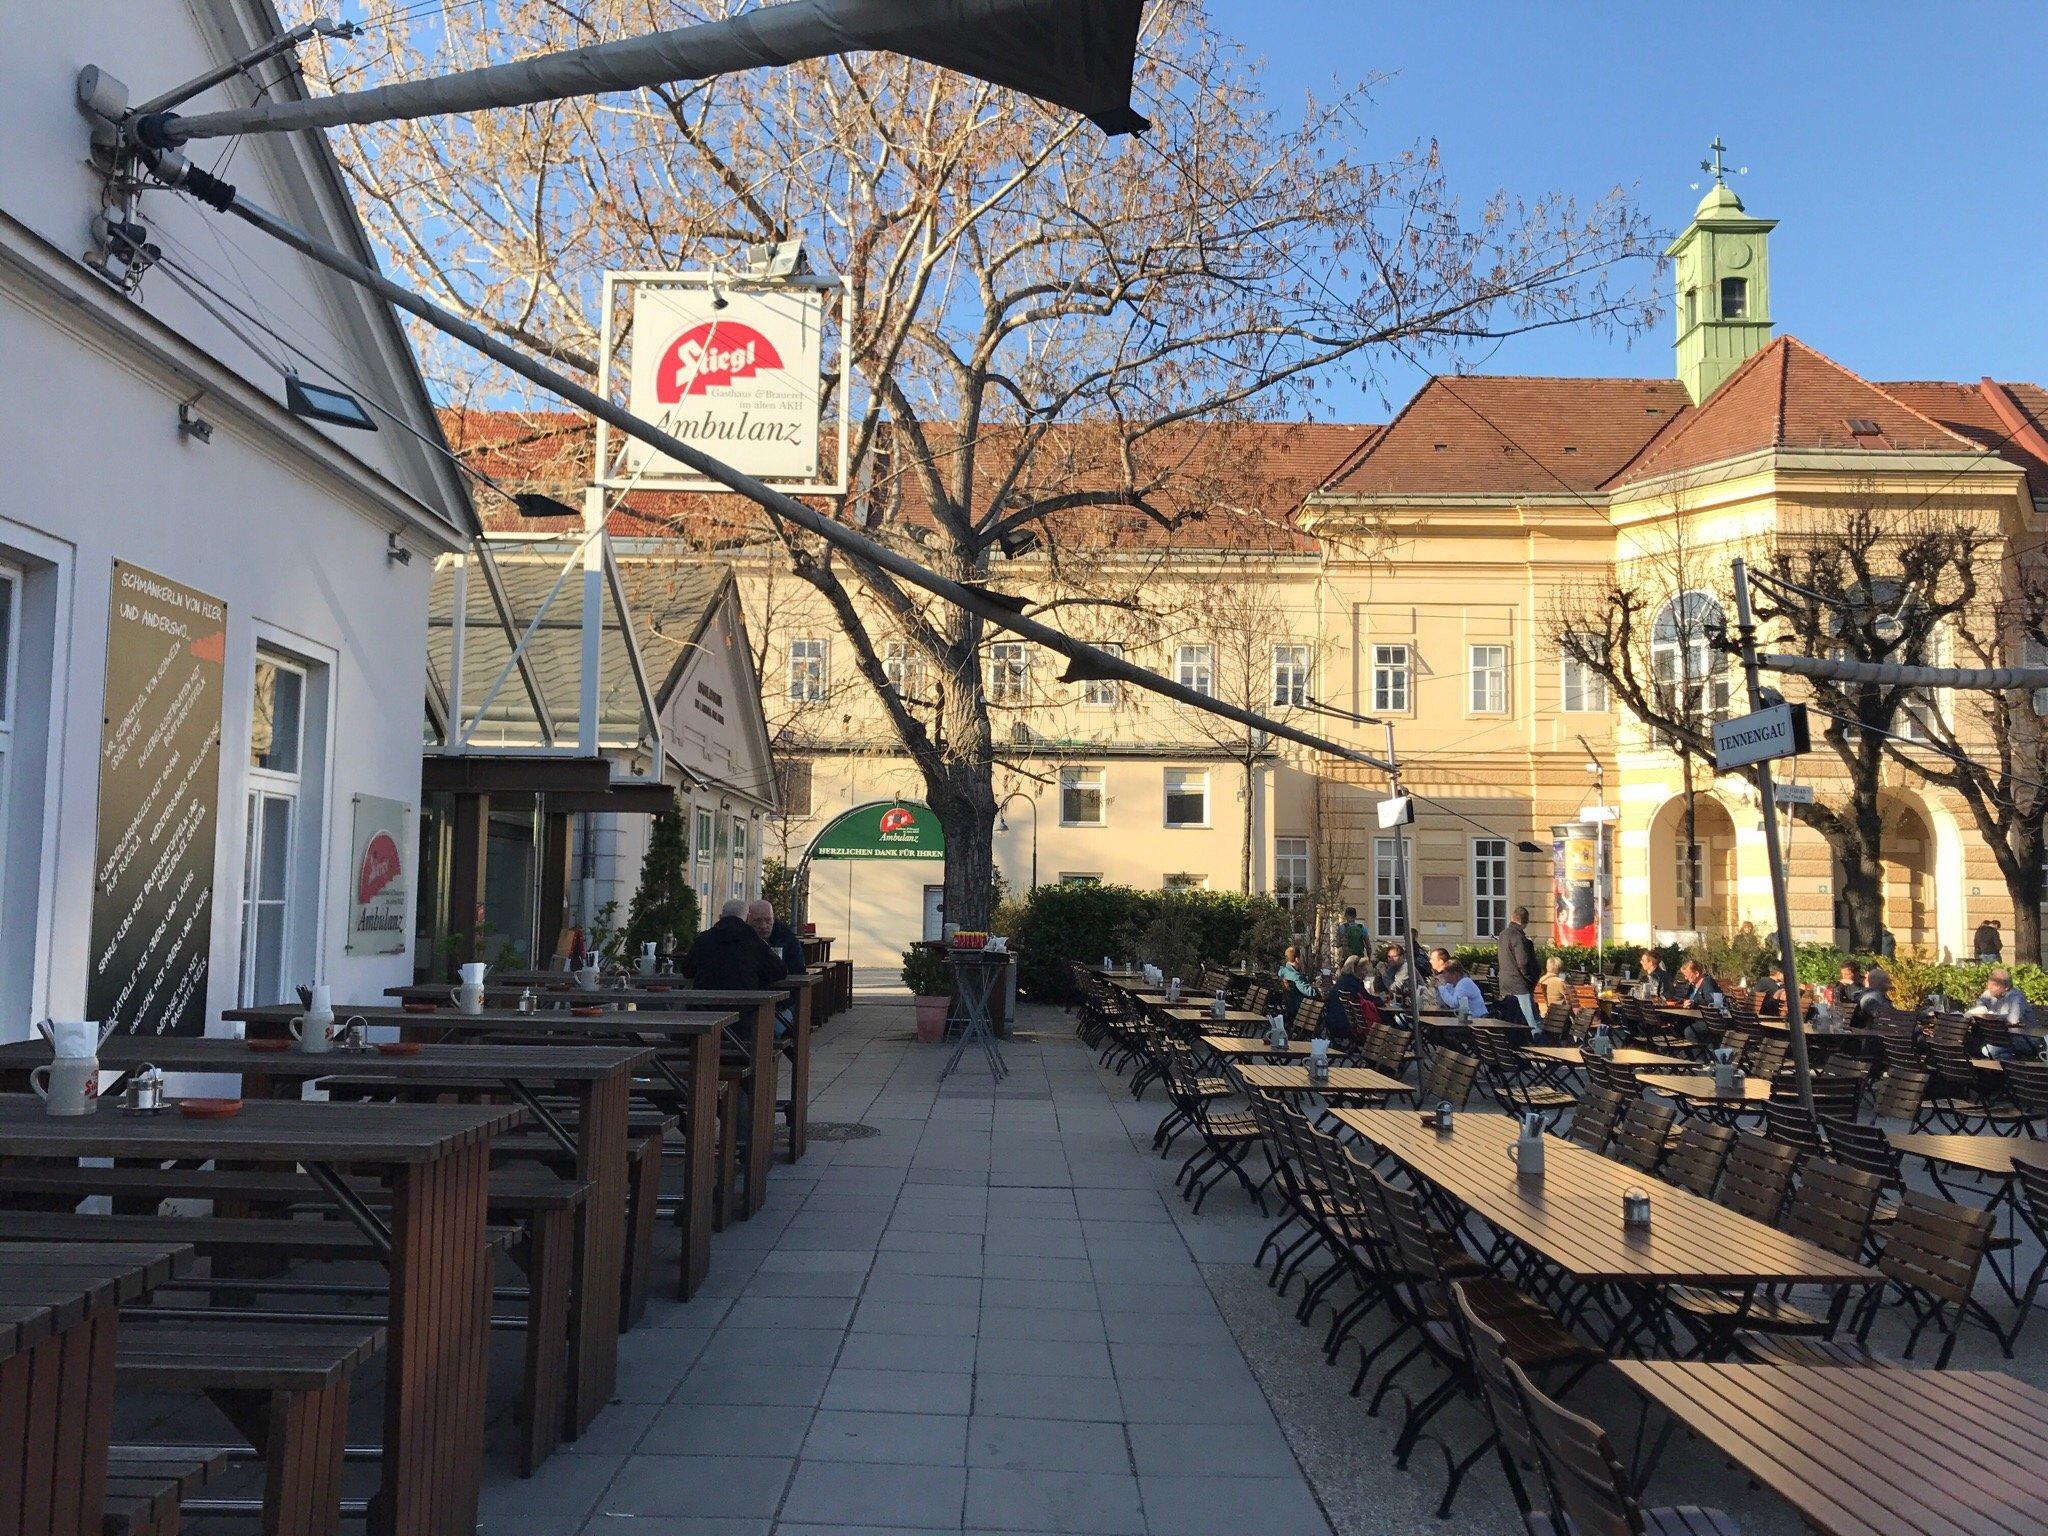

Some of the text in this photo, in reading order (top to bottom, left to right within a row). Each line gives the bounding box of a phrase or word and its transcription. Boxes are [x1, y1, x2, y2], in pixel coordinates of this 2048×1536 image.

[676, 339, 755, 388] Stiegl
[711, 389, 752, 398] Gasthaus
[740, 401, 803, 410] im alten AKH
[656, 410, 802, 446] Ambulanz
[120, 603, 139, 620] UND
[185, 594, 200, 613] VON
[202, 604, 222, 622] HIER
[145, 676, 158, 694] VON
[190, 664, 199, 681] MIT
[112, 718, 141, 770] ODER PUTE
[1719, 722, 1786, 750] TENNENGAU
[151, 778, 161, 799] MIT
[163, 750, 180, 780] GRANA
[819, 848, 873, 856] HERZLICHEN
[899, 849, 915, 857] FÜR
[917, 850, 943, 858] IHREN
[880, 832, 919, 843] Ambulanz
[107, 835, 142, 896] AUF RUCOLA
[99, 937, 117, 974] SPARE
[117, 913, 133, 941] RIBS
[132, 892, 143, 915] MIT
[188, 798, 198, 817] UND
[137, 950, 148, 974] MIT
[149, 920, 166, 953] OBERS
[165, 901, 177, 921] UND
[177, 870, 194, 902] LACHS
[357, 906, 403, 933] Ambulanz
[130, 887, 208, 1034] GNOCCHI MIT OBERS UND LACHS
[177, 973, 189, 994] WOK
[188, 953, 198, 974] MIT
[171, 958, 206, 1028] BASMATI REIS
